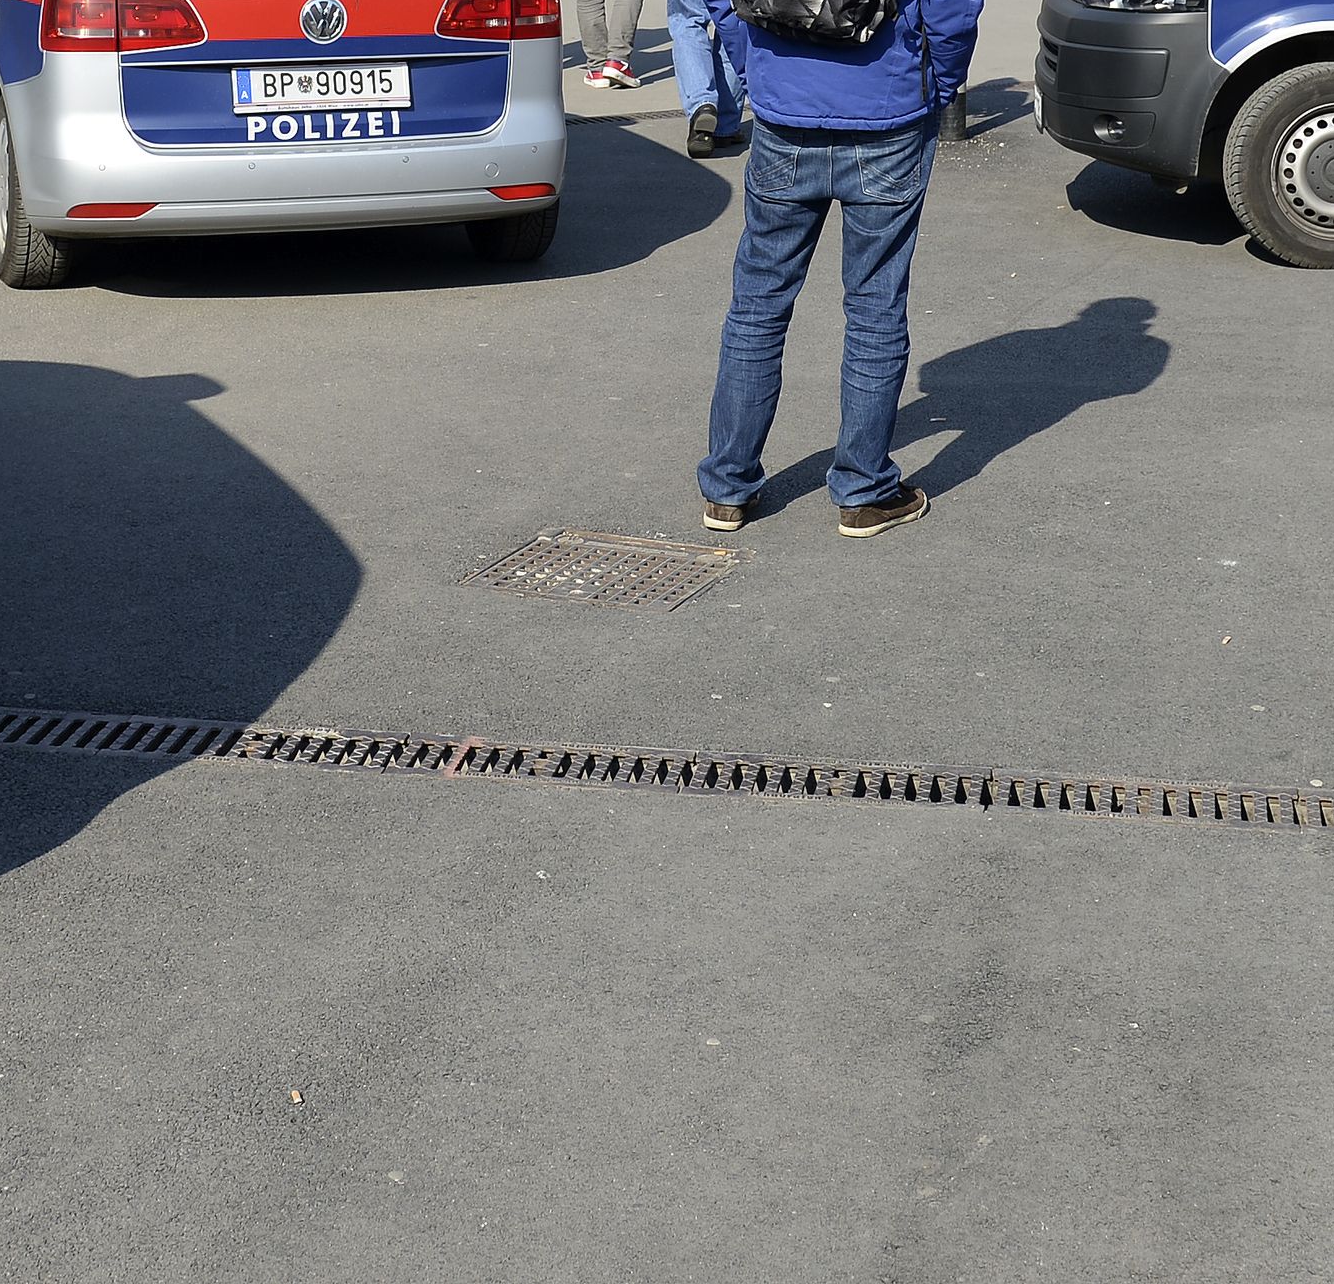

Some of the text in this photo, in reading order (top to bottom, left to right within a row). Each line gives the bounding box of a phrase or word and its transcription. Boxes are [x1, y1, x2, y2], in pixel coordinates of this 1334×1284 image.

[241, 69, 393, 100] A BP 90915
[246, 111, 400, 142] POLIZEI
